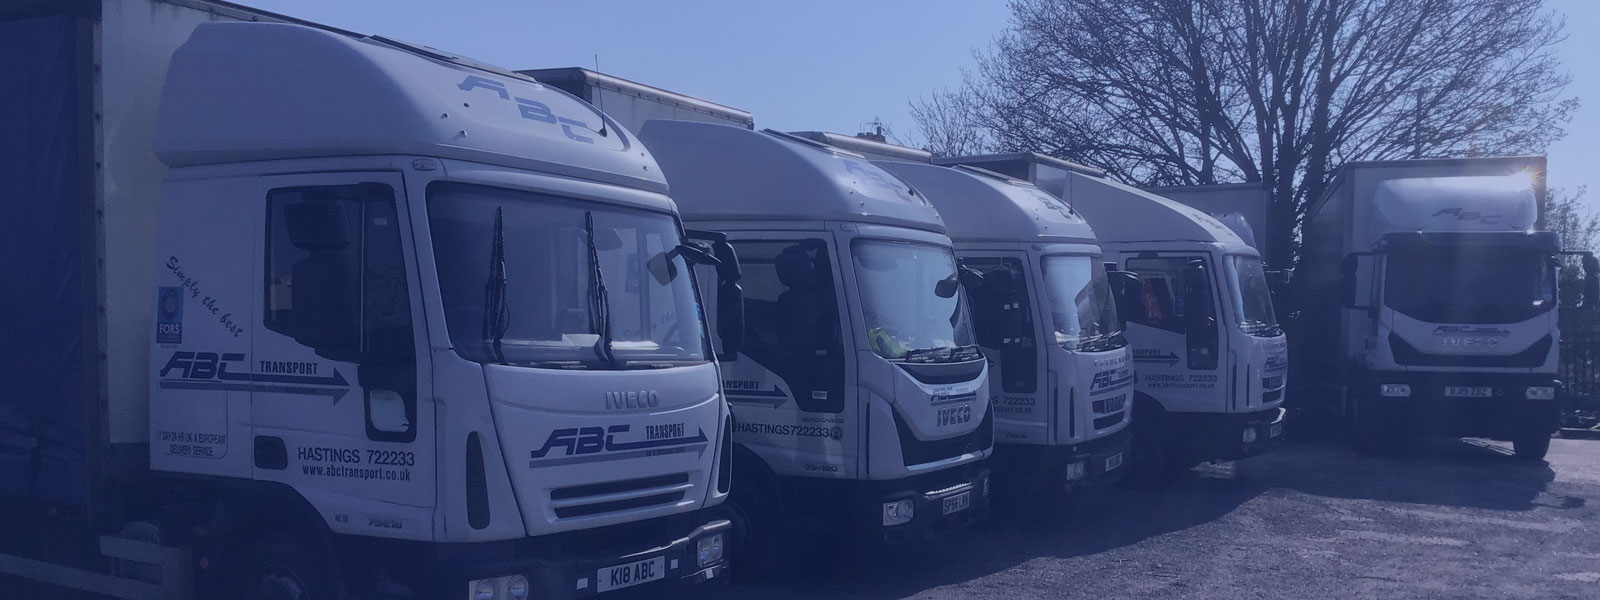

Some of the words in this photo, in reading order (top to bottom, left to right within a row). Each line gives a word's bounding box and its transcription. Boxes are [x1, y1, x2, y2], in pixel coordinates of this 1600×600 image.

[166, 256, 201, 299] Simply
[202, 295, 219, 316] the
[220, 312, 243, 338] best
[159, 323, 180, 335] FORS
[160, 351, 246, 380] ABC
[260, 360, 319, 375] TRANSPORT
[1144, 374, 1184, 382] HASTINGS
[1188, 374, 1217, 382] 722233
[605, 390, 660, 409] IVECO
[1002, 396, 1036, 406] 722233
[937, 404, 972, 427] IVECO
[531, 424, 631, 459] ABC
[645, 422, 685, 440] TRANSPORT
[297, 447, 360, 464] HASTINGS
[367, 449, 415, 467] 722233
[302, 465, 411, 482] www.abctransport.co.uk
[610, 564, 630, 587] K18
[634, 560, 655, 581] ABC
